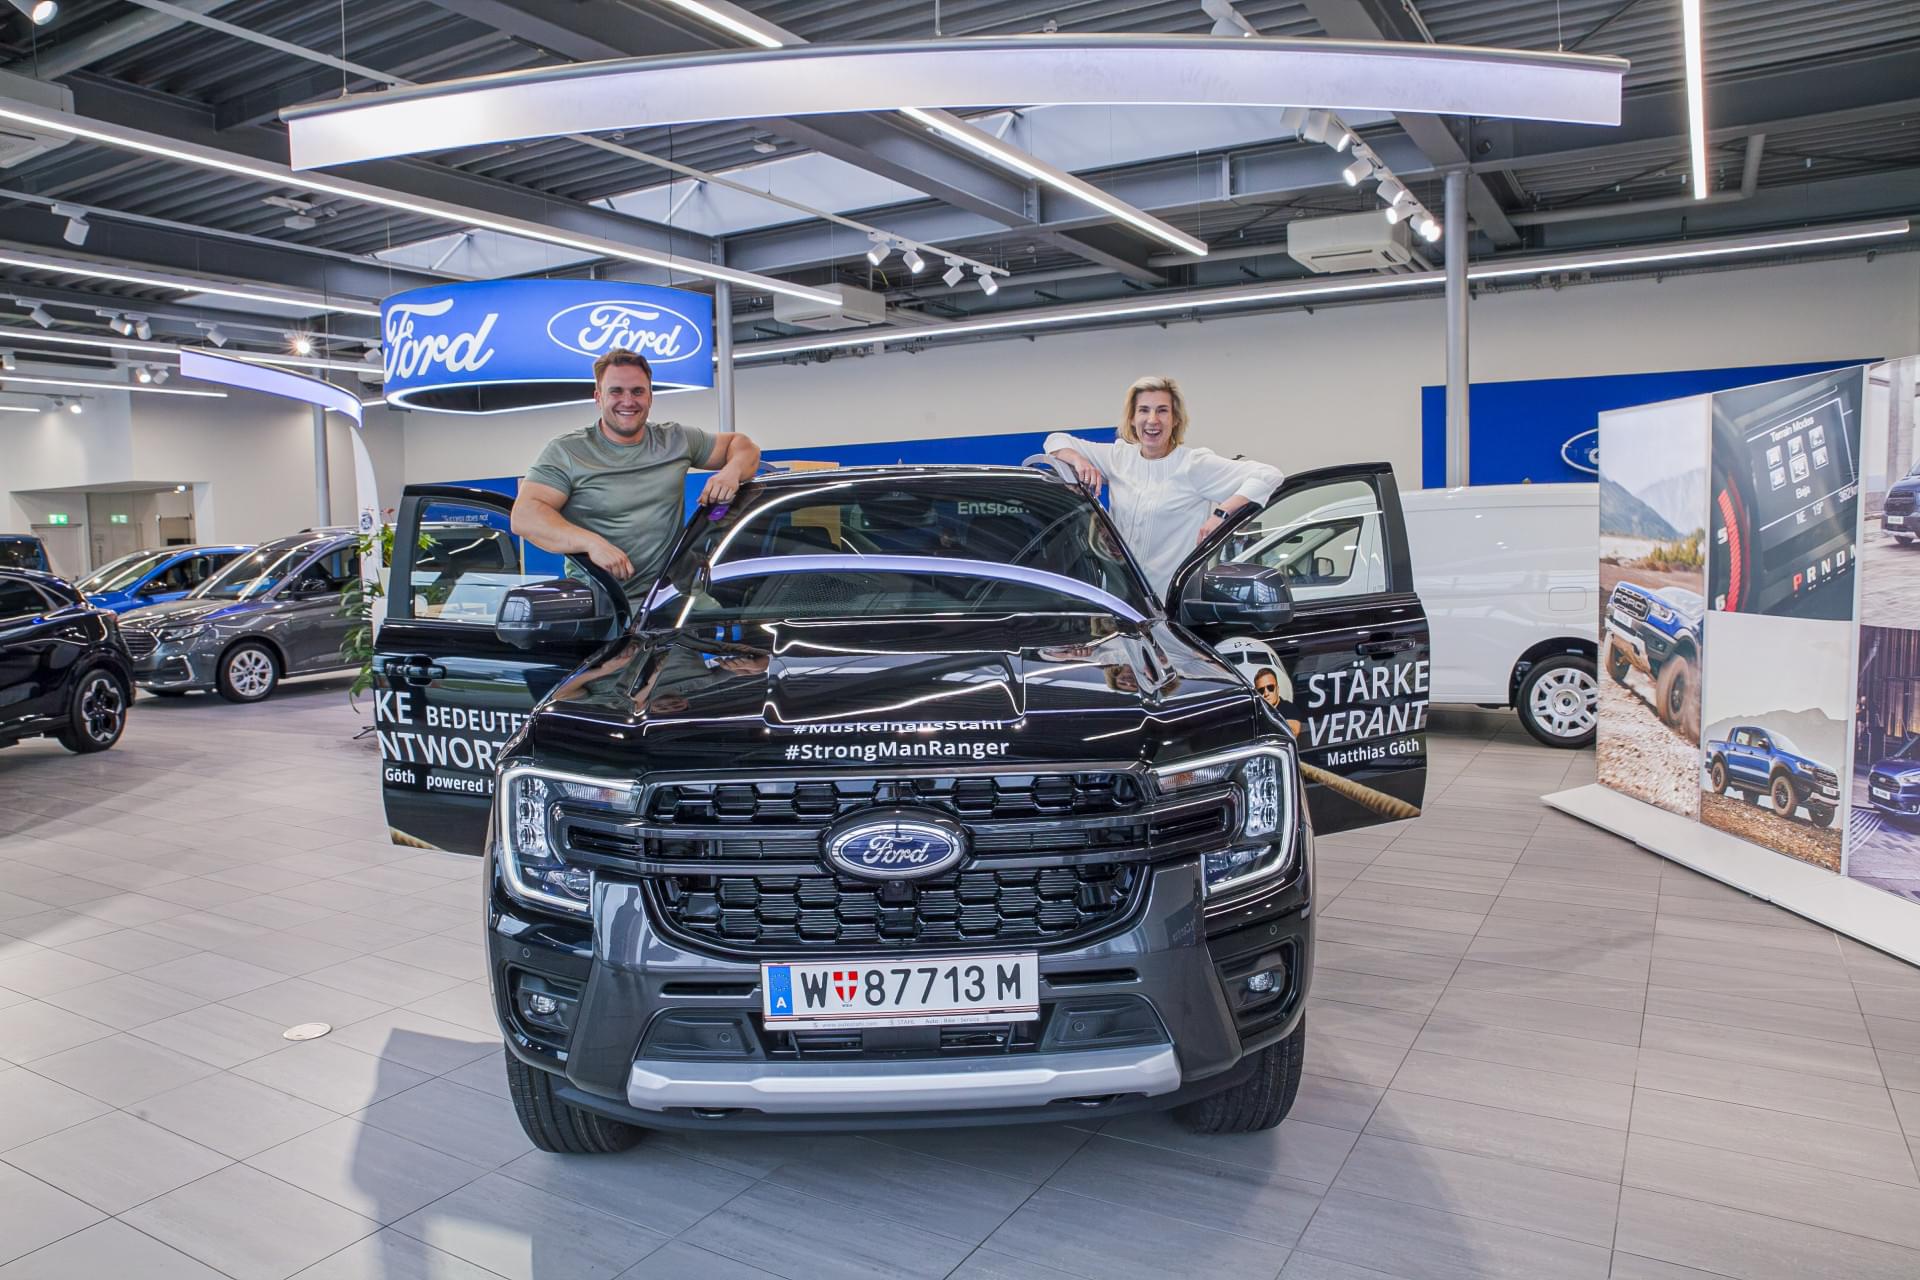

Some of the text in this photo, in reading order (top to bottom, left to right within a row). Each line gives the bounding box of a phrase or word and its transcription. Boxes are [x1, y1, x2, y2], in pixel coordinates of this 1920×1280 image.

[384, 298, 499, 384] Ford
[578, 305, 683, 357] Ford
[1793, 573, 1803, 592] P
[1807, 566, 1816, 583] R
[1821, 558, 1831, 575] N
[1836, 550, 1846, 567] D
[1308, 661, 1430, 708] STÄRKE
[375, 690, 413, 725] KE
[1308, 699, 1429, 747] VERANT
[785, 740, 1010, 761] #StrongManRanger
[1327, 738, 1420, 767] Matthias Göth
[385, 767, 416, 785] Göth
[426, 774, 484, 793] powered
[863, 835, 930, 864] Ford
[776, 996, 788, 1009] A
[801, 971, 829, 1009] W
